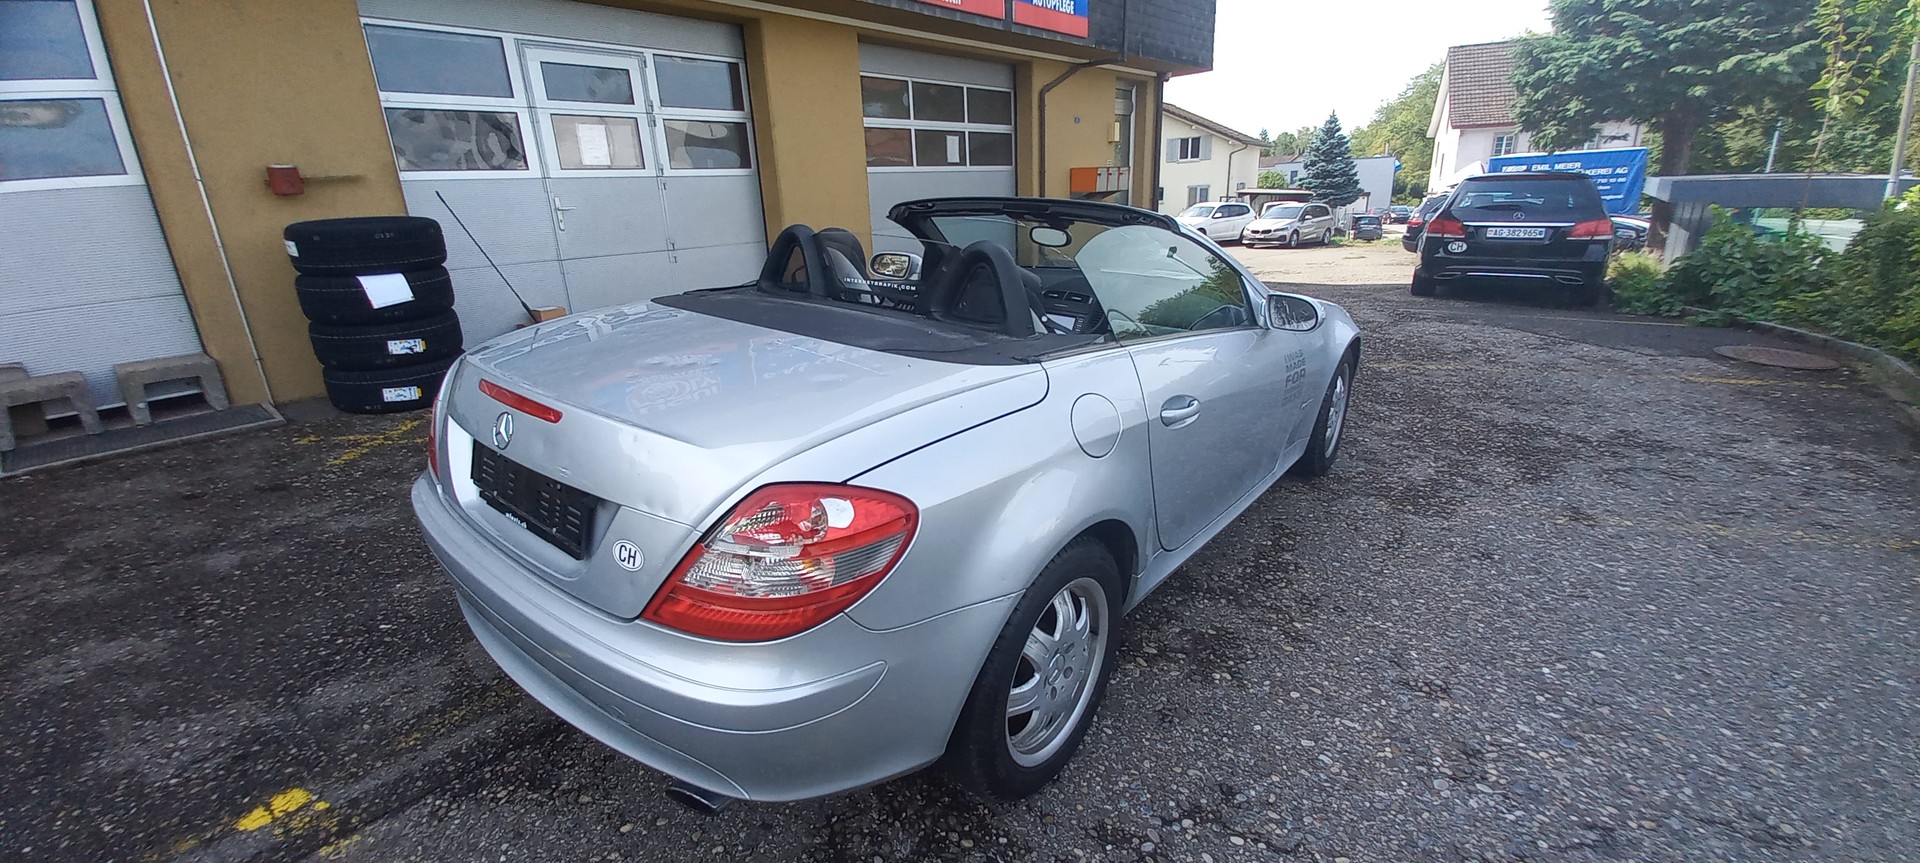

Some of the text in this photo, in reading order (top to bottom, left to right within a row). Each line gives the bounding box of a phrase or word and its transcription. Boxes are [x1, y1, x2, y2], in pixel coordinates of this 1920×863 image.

[1554, 162, 1581, 170] MEIER
[1615, 167, 1629, 175] AG
[1450, 242, 1464, 251] CH
[1286, 358, 1306, 373] MADE
[1285, 369, 1305, 388] FOR
[618, 544, 638, 567] CH
